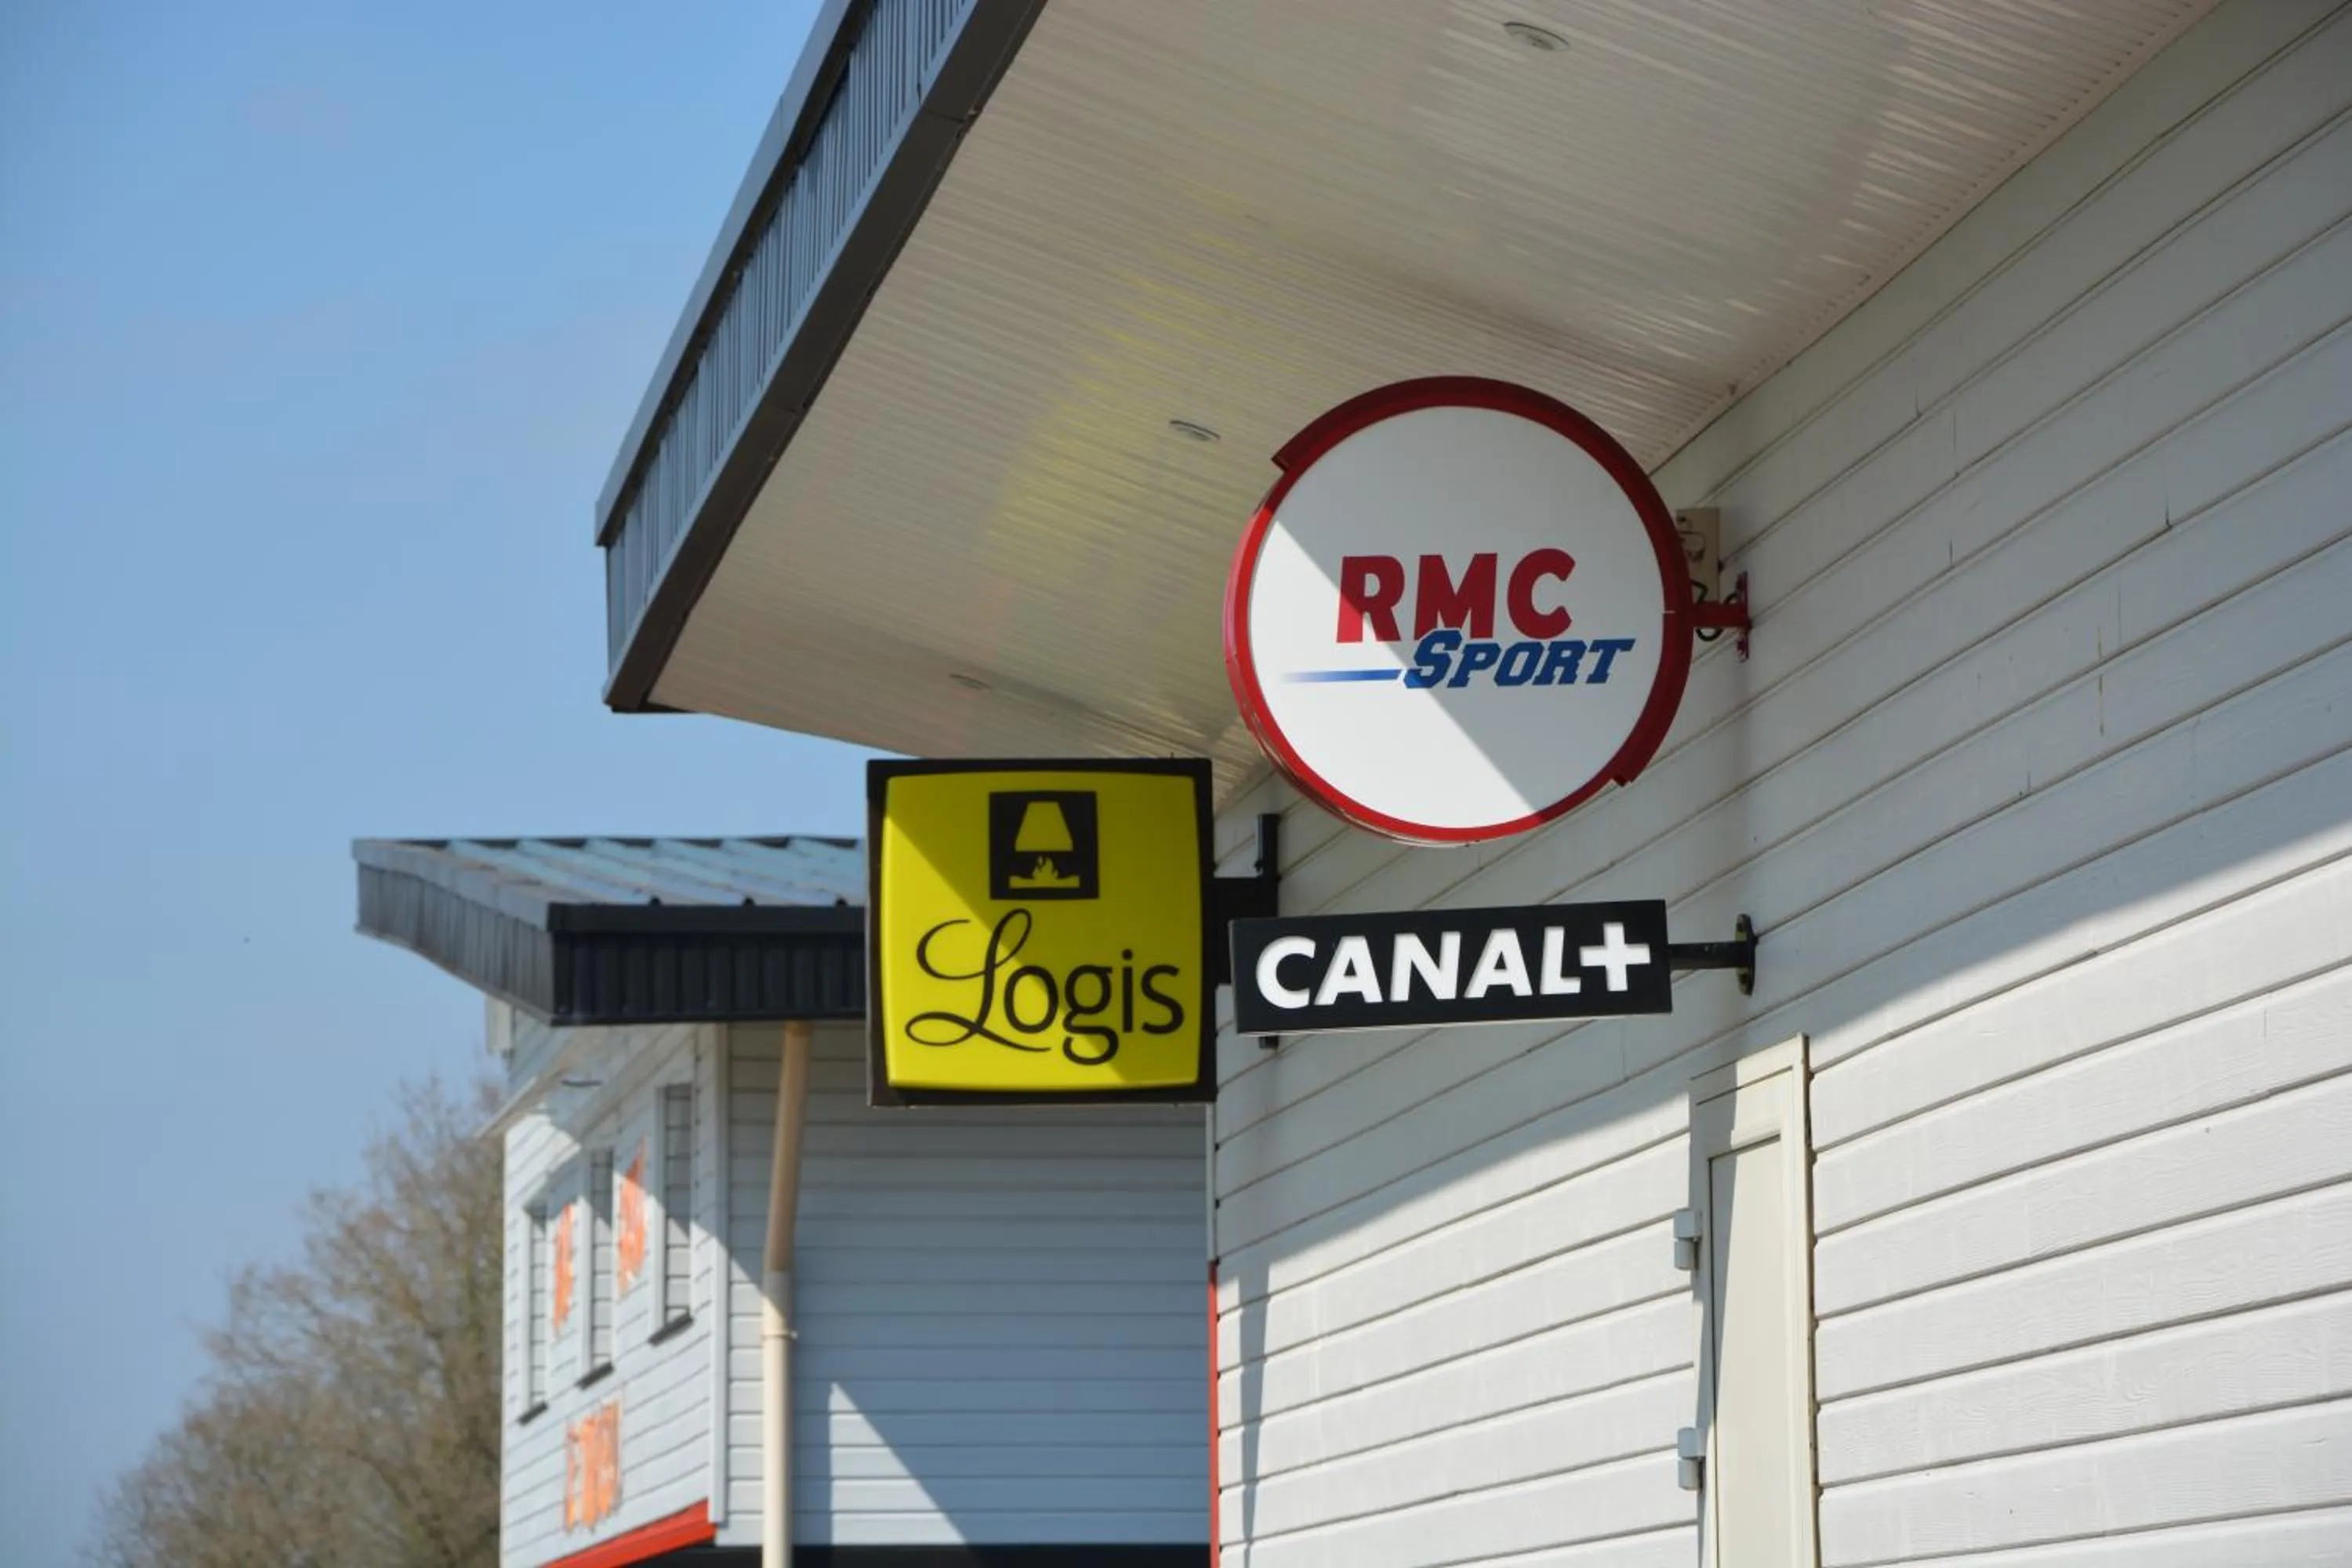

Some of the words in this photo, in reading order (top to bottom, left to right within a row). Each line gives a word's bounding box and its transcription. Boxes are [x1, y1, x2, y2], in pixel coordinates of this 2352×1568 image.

[1336, 547, 1576, 643] RMC
[905, 907, 1185, 1066] Logis
[1255, 921, 1651, 1010] CANAL+
